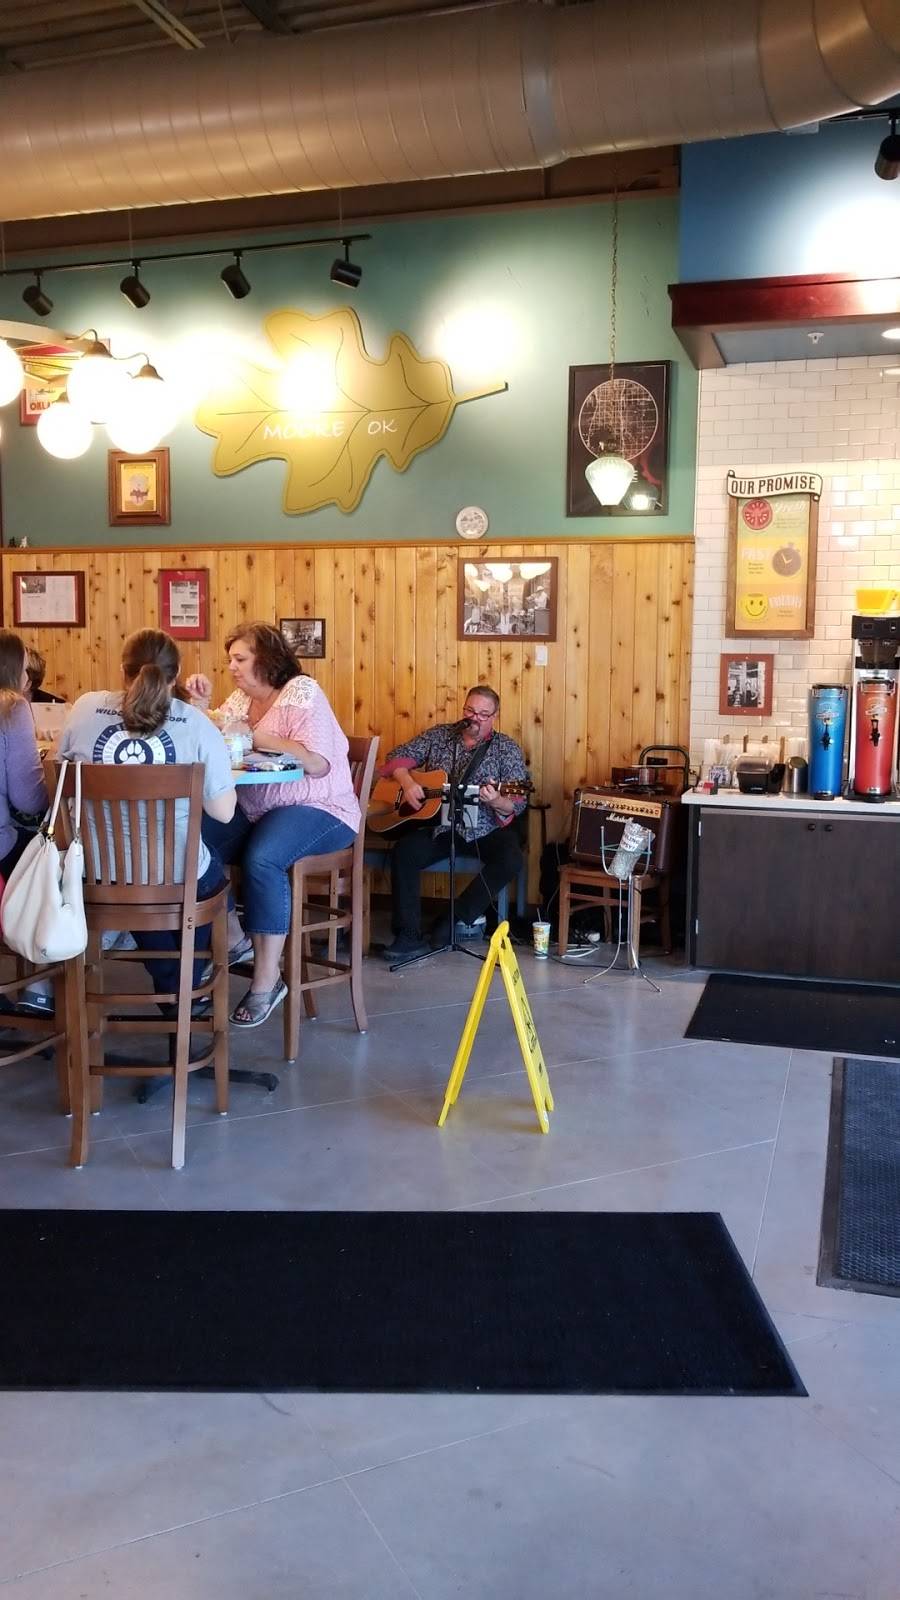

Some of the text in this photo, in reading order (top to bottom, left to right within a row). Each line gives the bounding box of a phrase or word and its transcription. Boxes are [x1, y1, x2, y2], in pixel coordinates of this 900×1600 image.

[263, 418, 398, 440] MOORE OK
[731, 475, 816, 494] OUR PROMISE
[95, 707, 124, 717] WILDC
